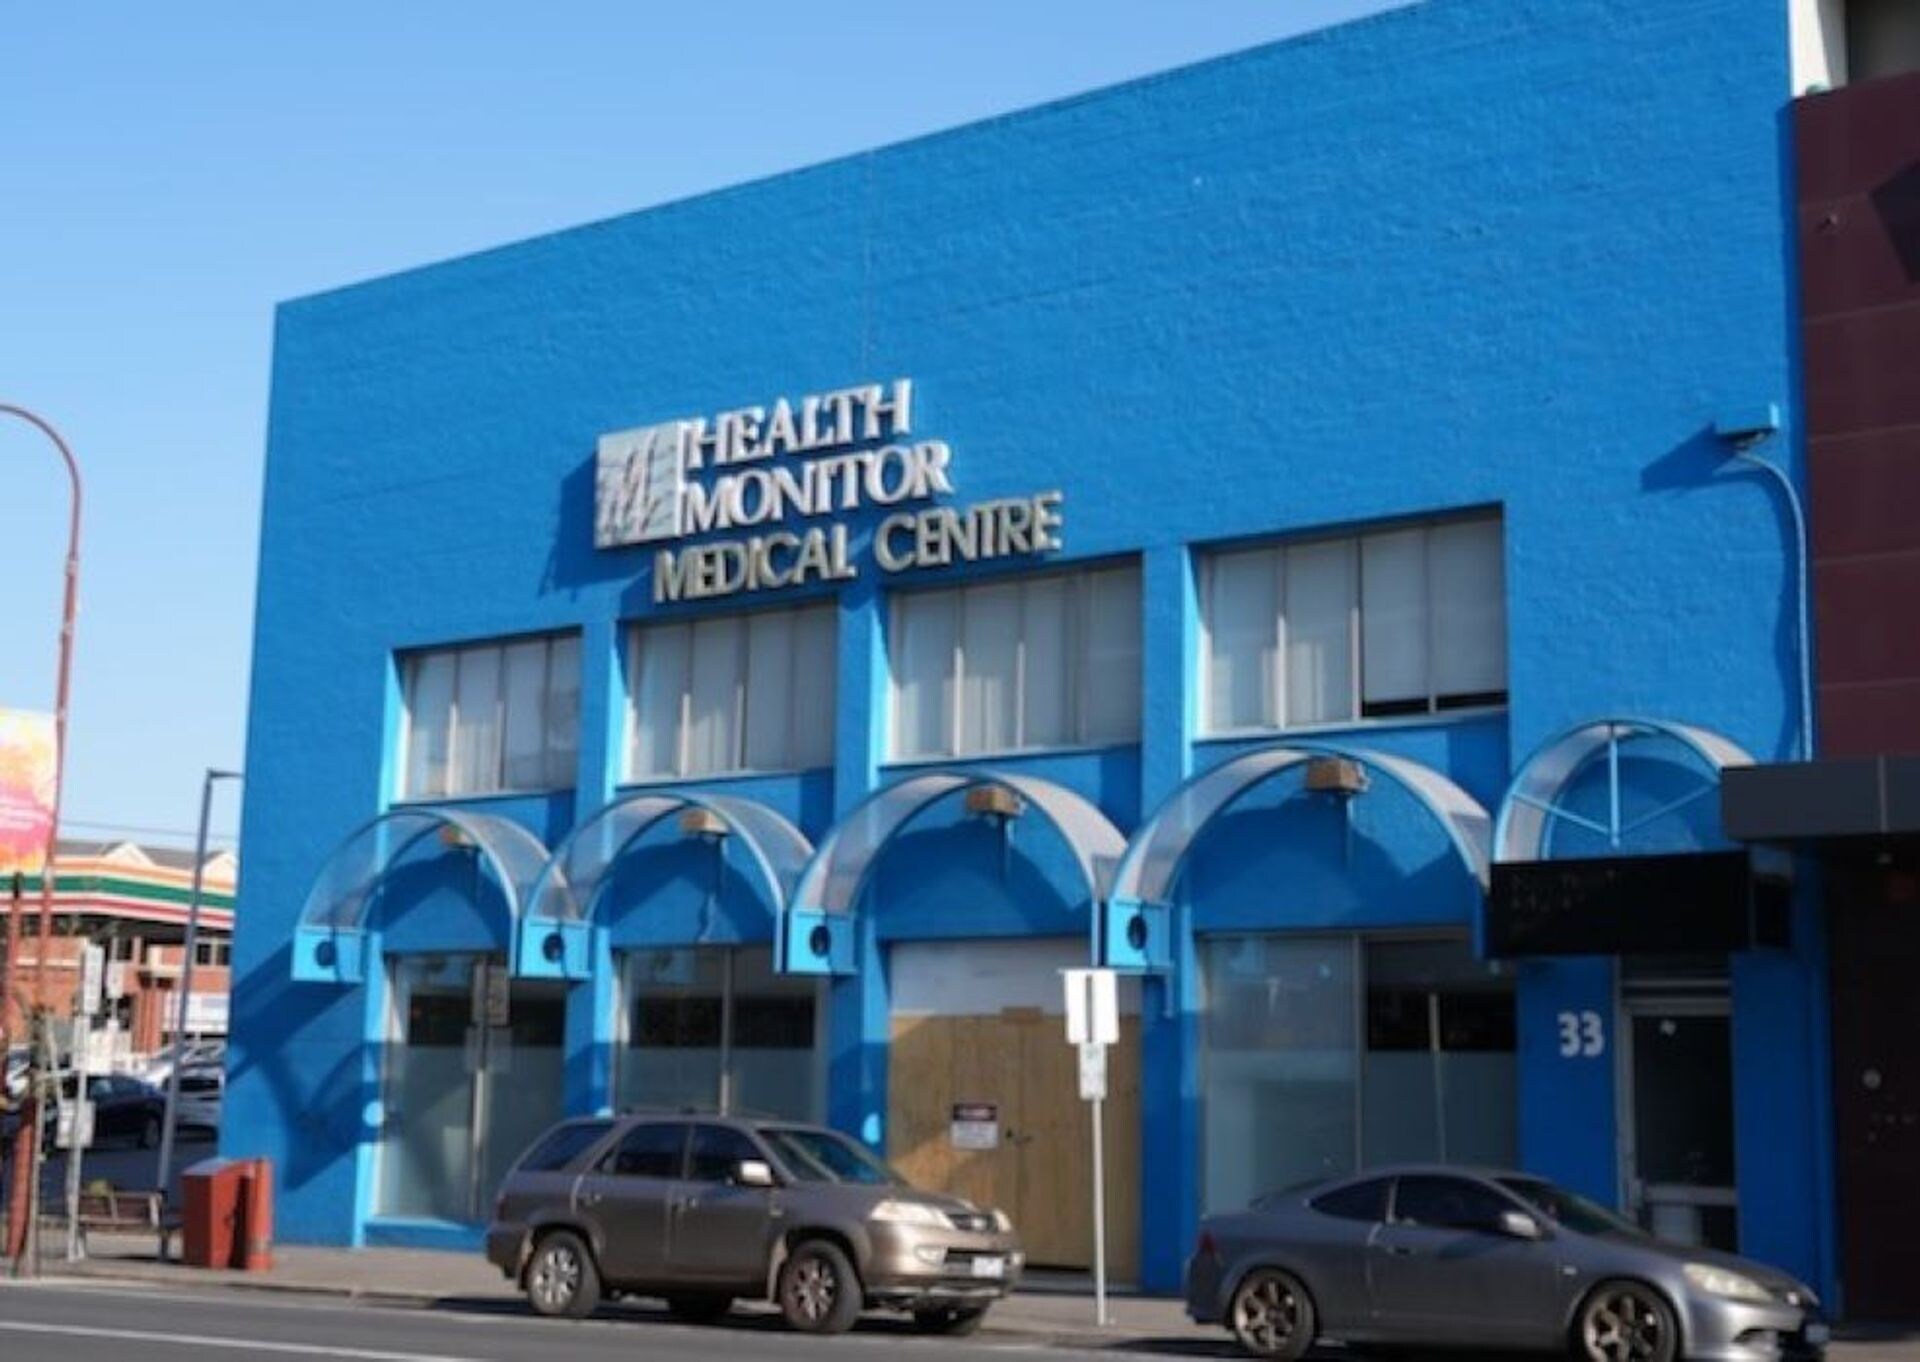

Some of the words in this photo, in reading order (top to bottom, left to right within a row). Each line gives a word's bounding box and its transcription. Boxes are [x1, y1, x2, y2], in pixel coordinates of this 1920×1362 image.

[684, 378, 912, 469] HEALTH
[682, 440, 954, 536] MONITOR
[653, 523, 857, 602] MEDICAL
[874, 491, 1063, 571] CENTRE
[1558, 1011, 1604, 1058] 33
